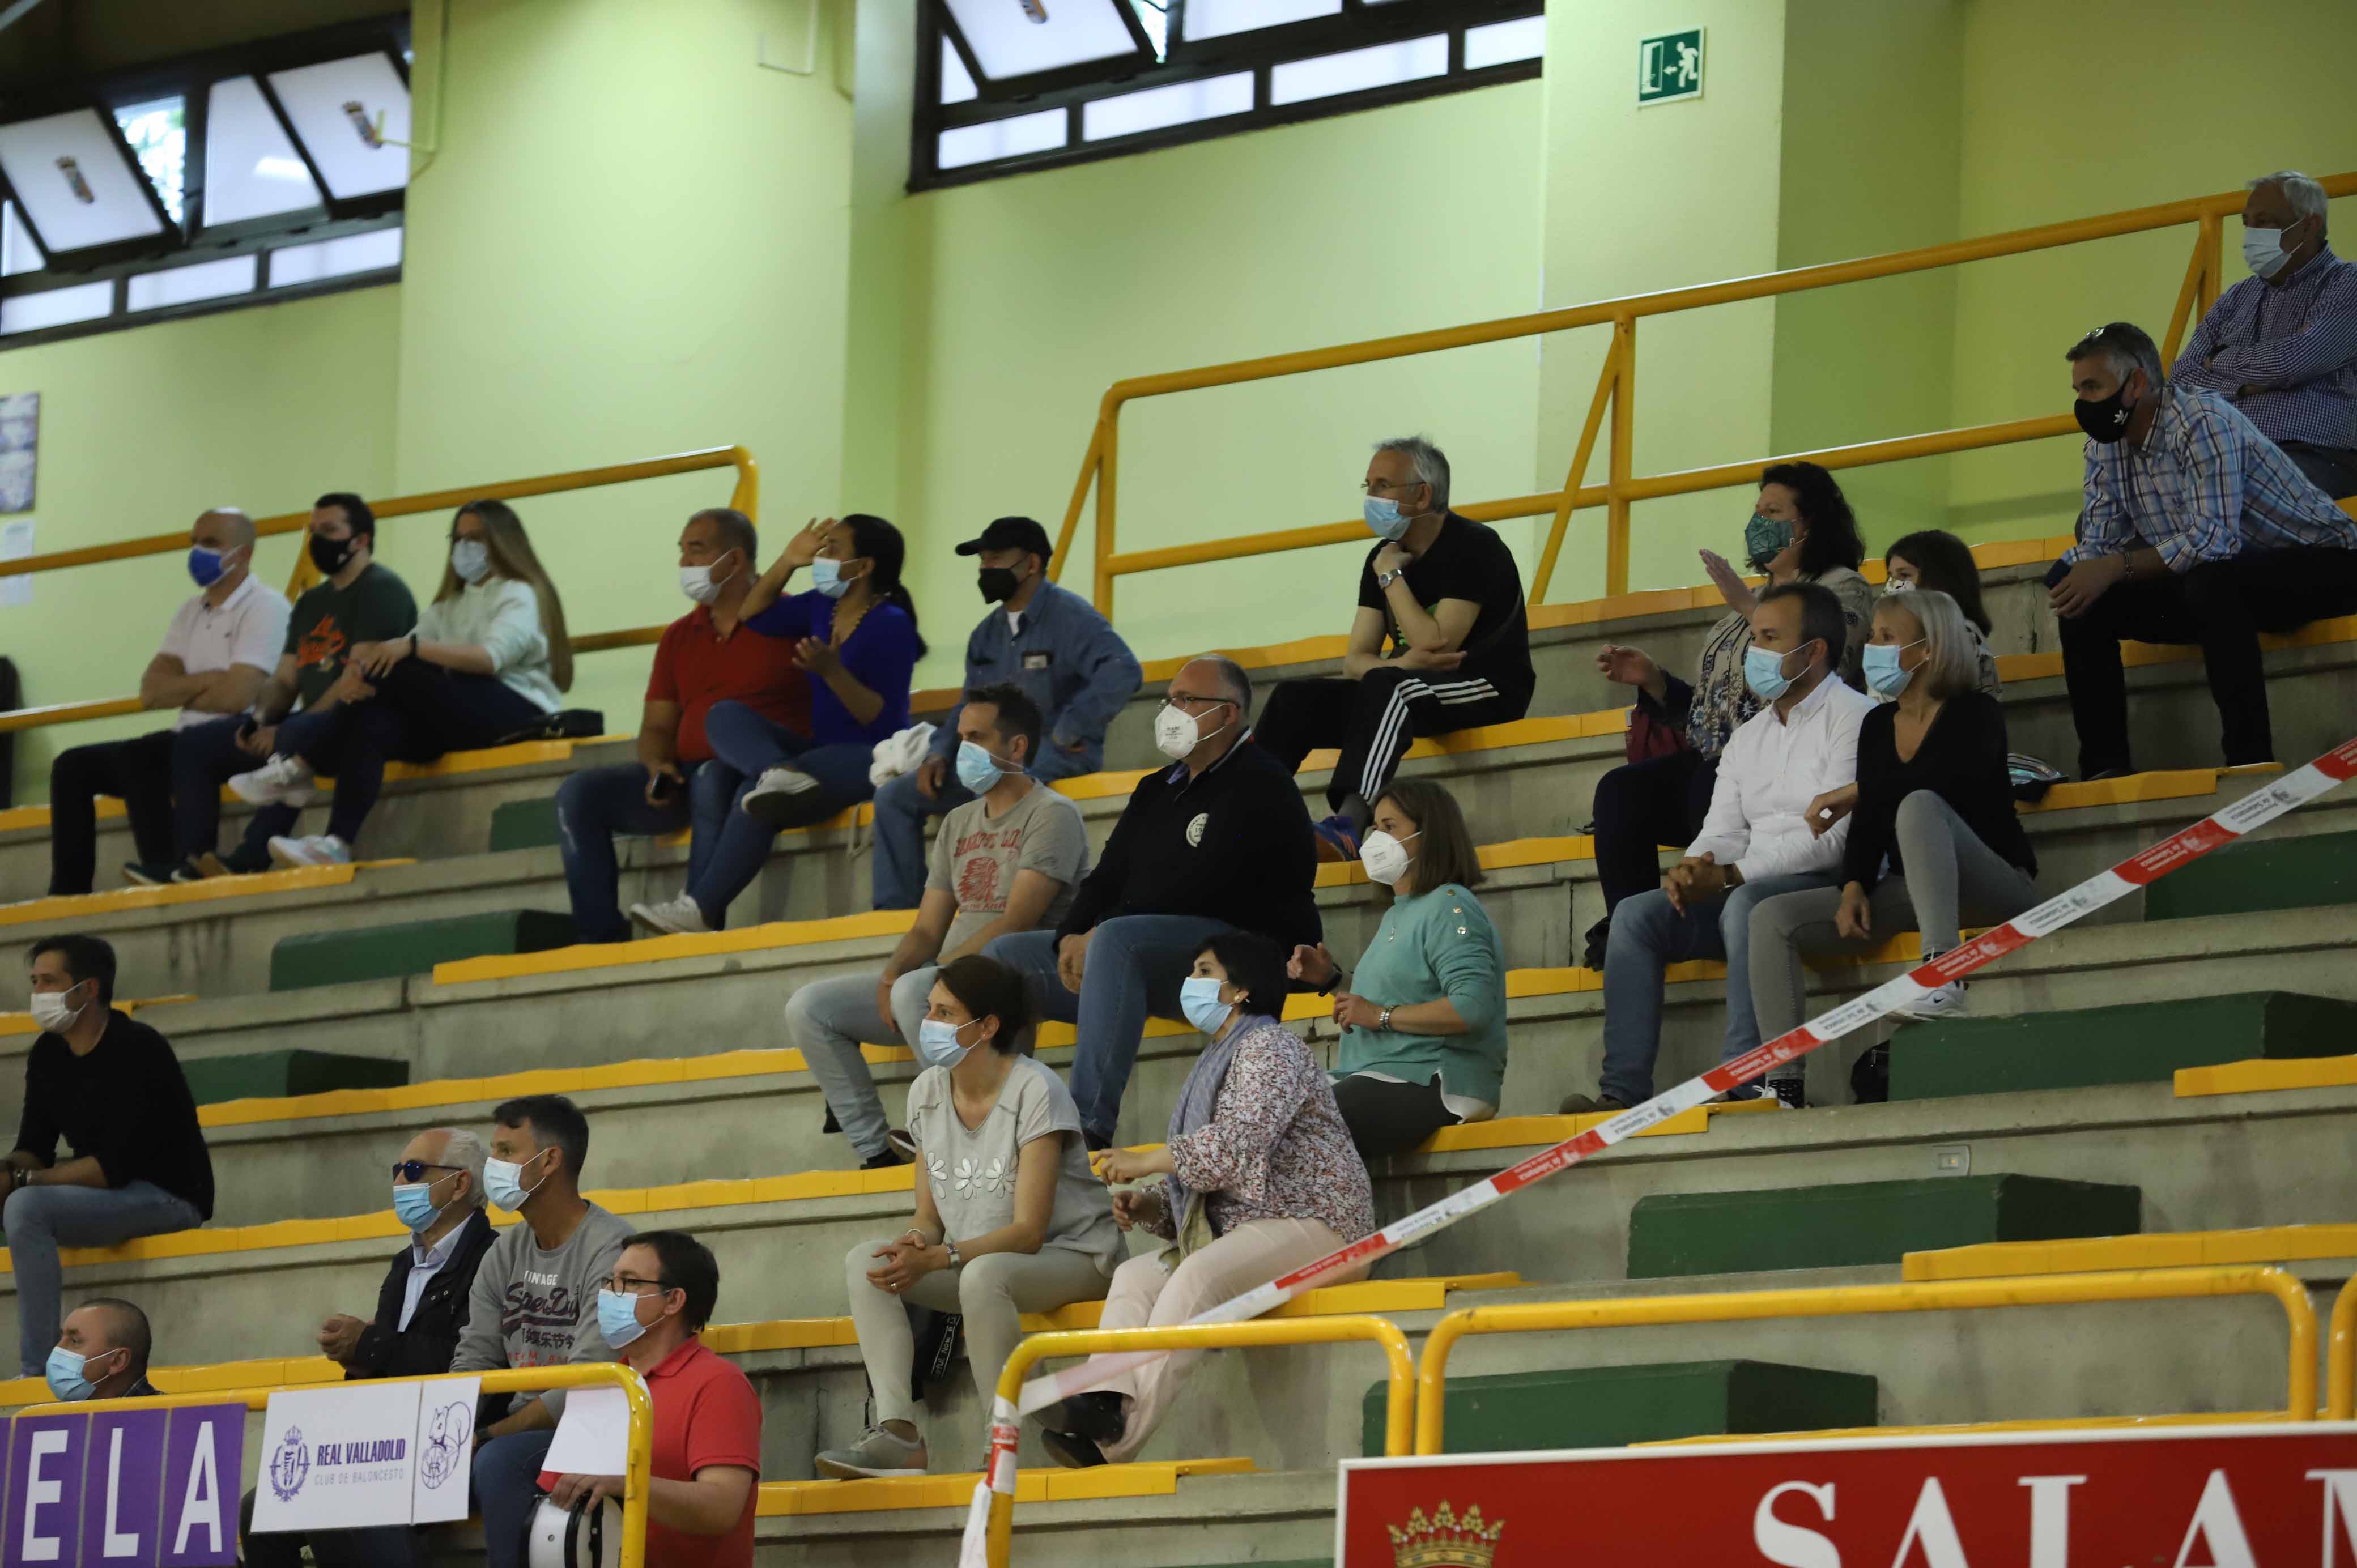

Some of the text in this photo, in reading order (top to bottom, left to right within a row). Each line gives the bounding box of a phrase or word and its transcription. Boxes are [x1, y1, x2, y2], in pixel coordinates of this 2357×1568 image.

[317, 1438, 406, 1466] REAL VALLADOLID
[314, 1468, 404, 1485] CLUB DE BALONCESTO
